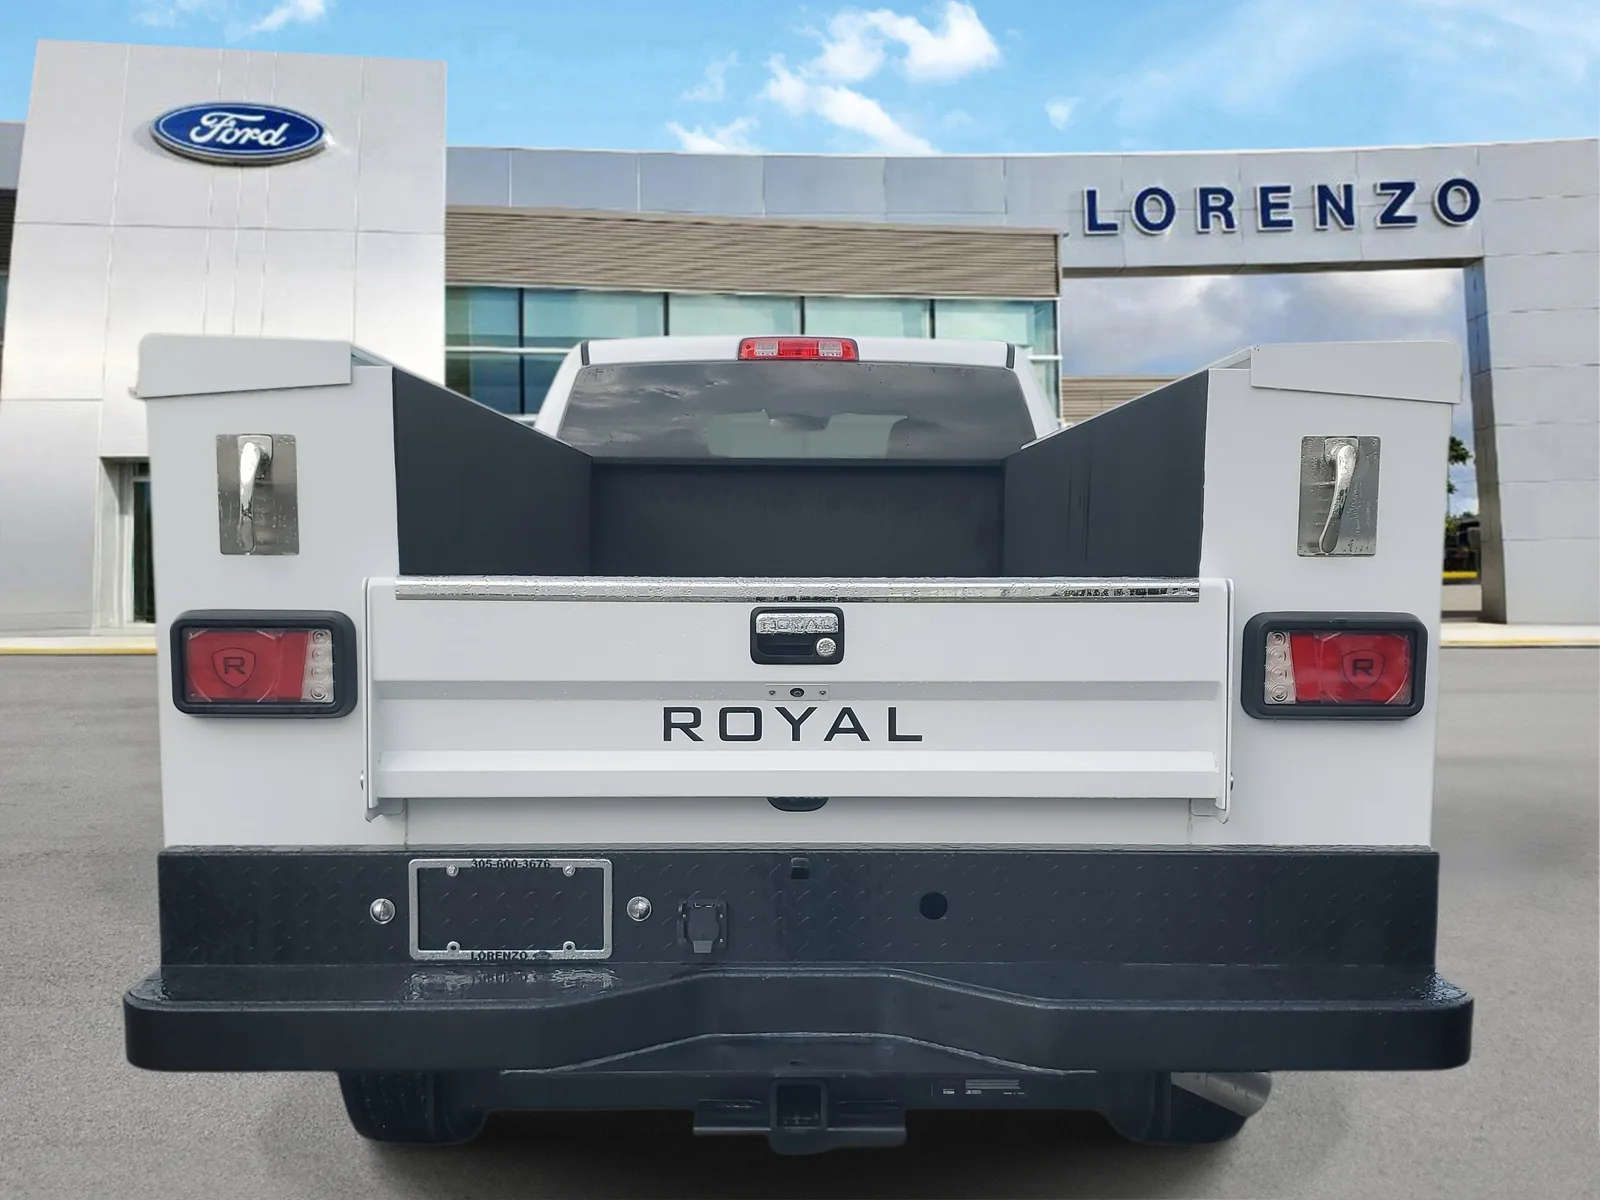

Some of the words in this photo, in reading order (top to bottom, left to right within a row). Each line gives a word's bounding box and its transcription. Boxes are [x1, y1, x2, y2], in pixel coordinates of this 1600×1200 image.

[190, 112, 290, 146] Ford
[1083, 178, 1481, 235] LORENZO
[223, 656, 246, 674] R
[1353, 658, 1375, 676] R
[663, 706, 923, 742] ROYAL
[471, 858, 551, 869] 305-600-3676
[470, 950, 528, 961] LORENZO
